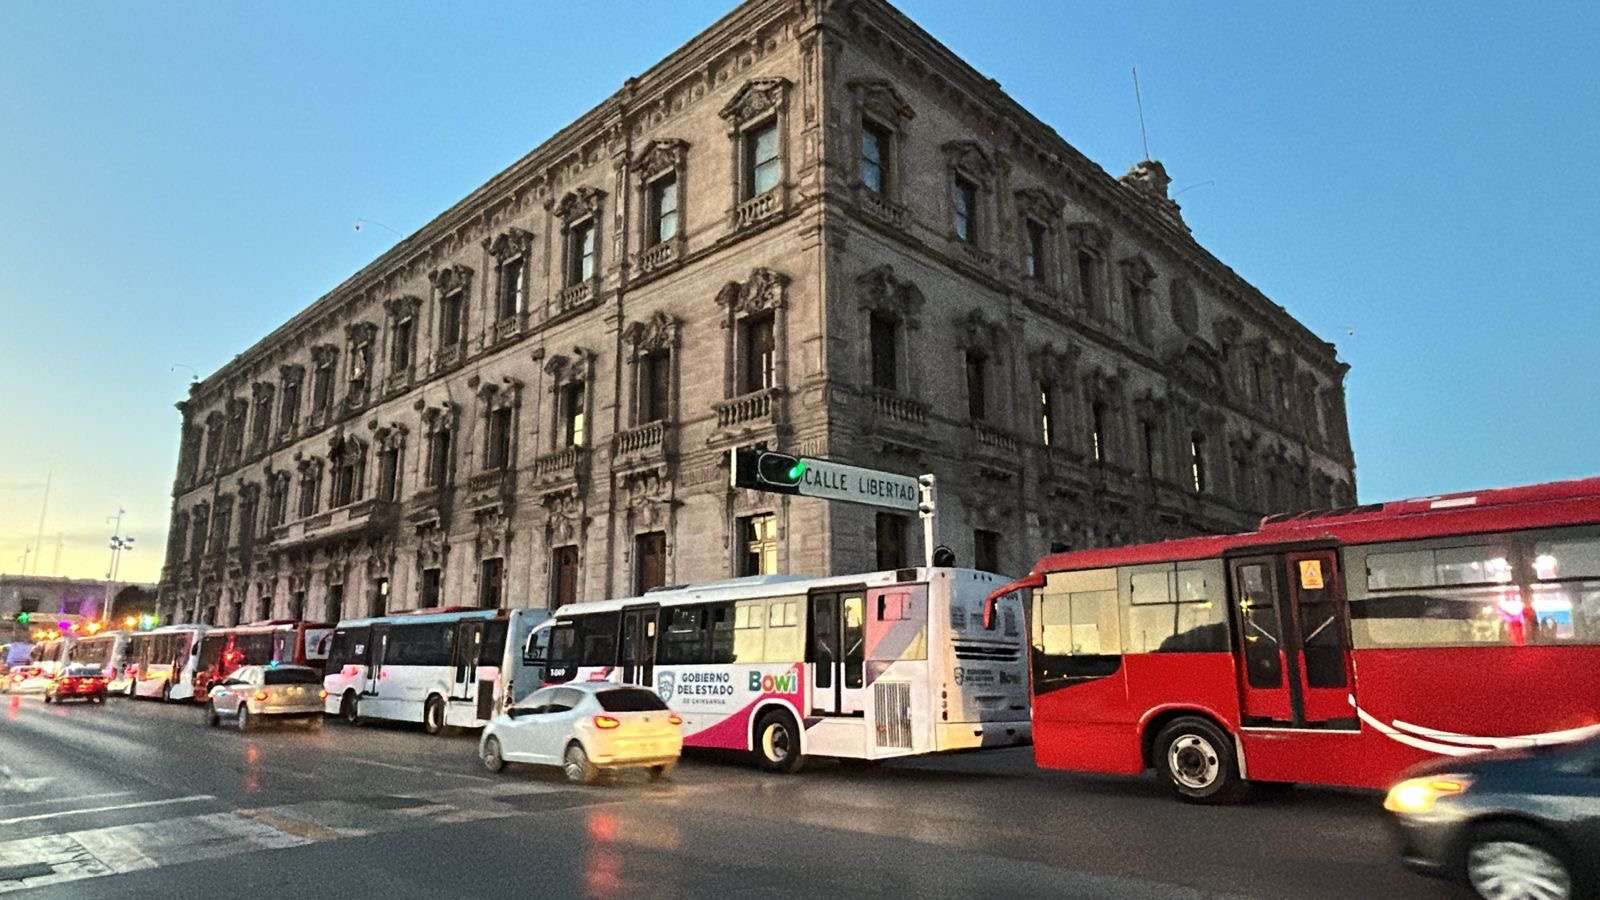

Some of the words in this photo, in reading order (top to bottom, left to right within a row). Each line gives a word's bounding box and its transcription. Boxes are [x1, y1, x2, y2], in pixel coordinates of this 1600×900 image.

[805, 467, 848, 491] CALLE
[858, 478, 915, 501] LIBERTAD
[681, 672, 730, 683] GOBIERNO
[677, 684, 694, 695] DEL
[695, 684, 734, 696] ESTADO
